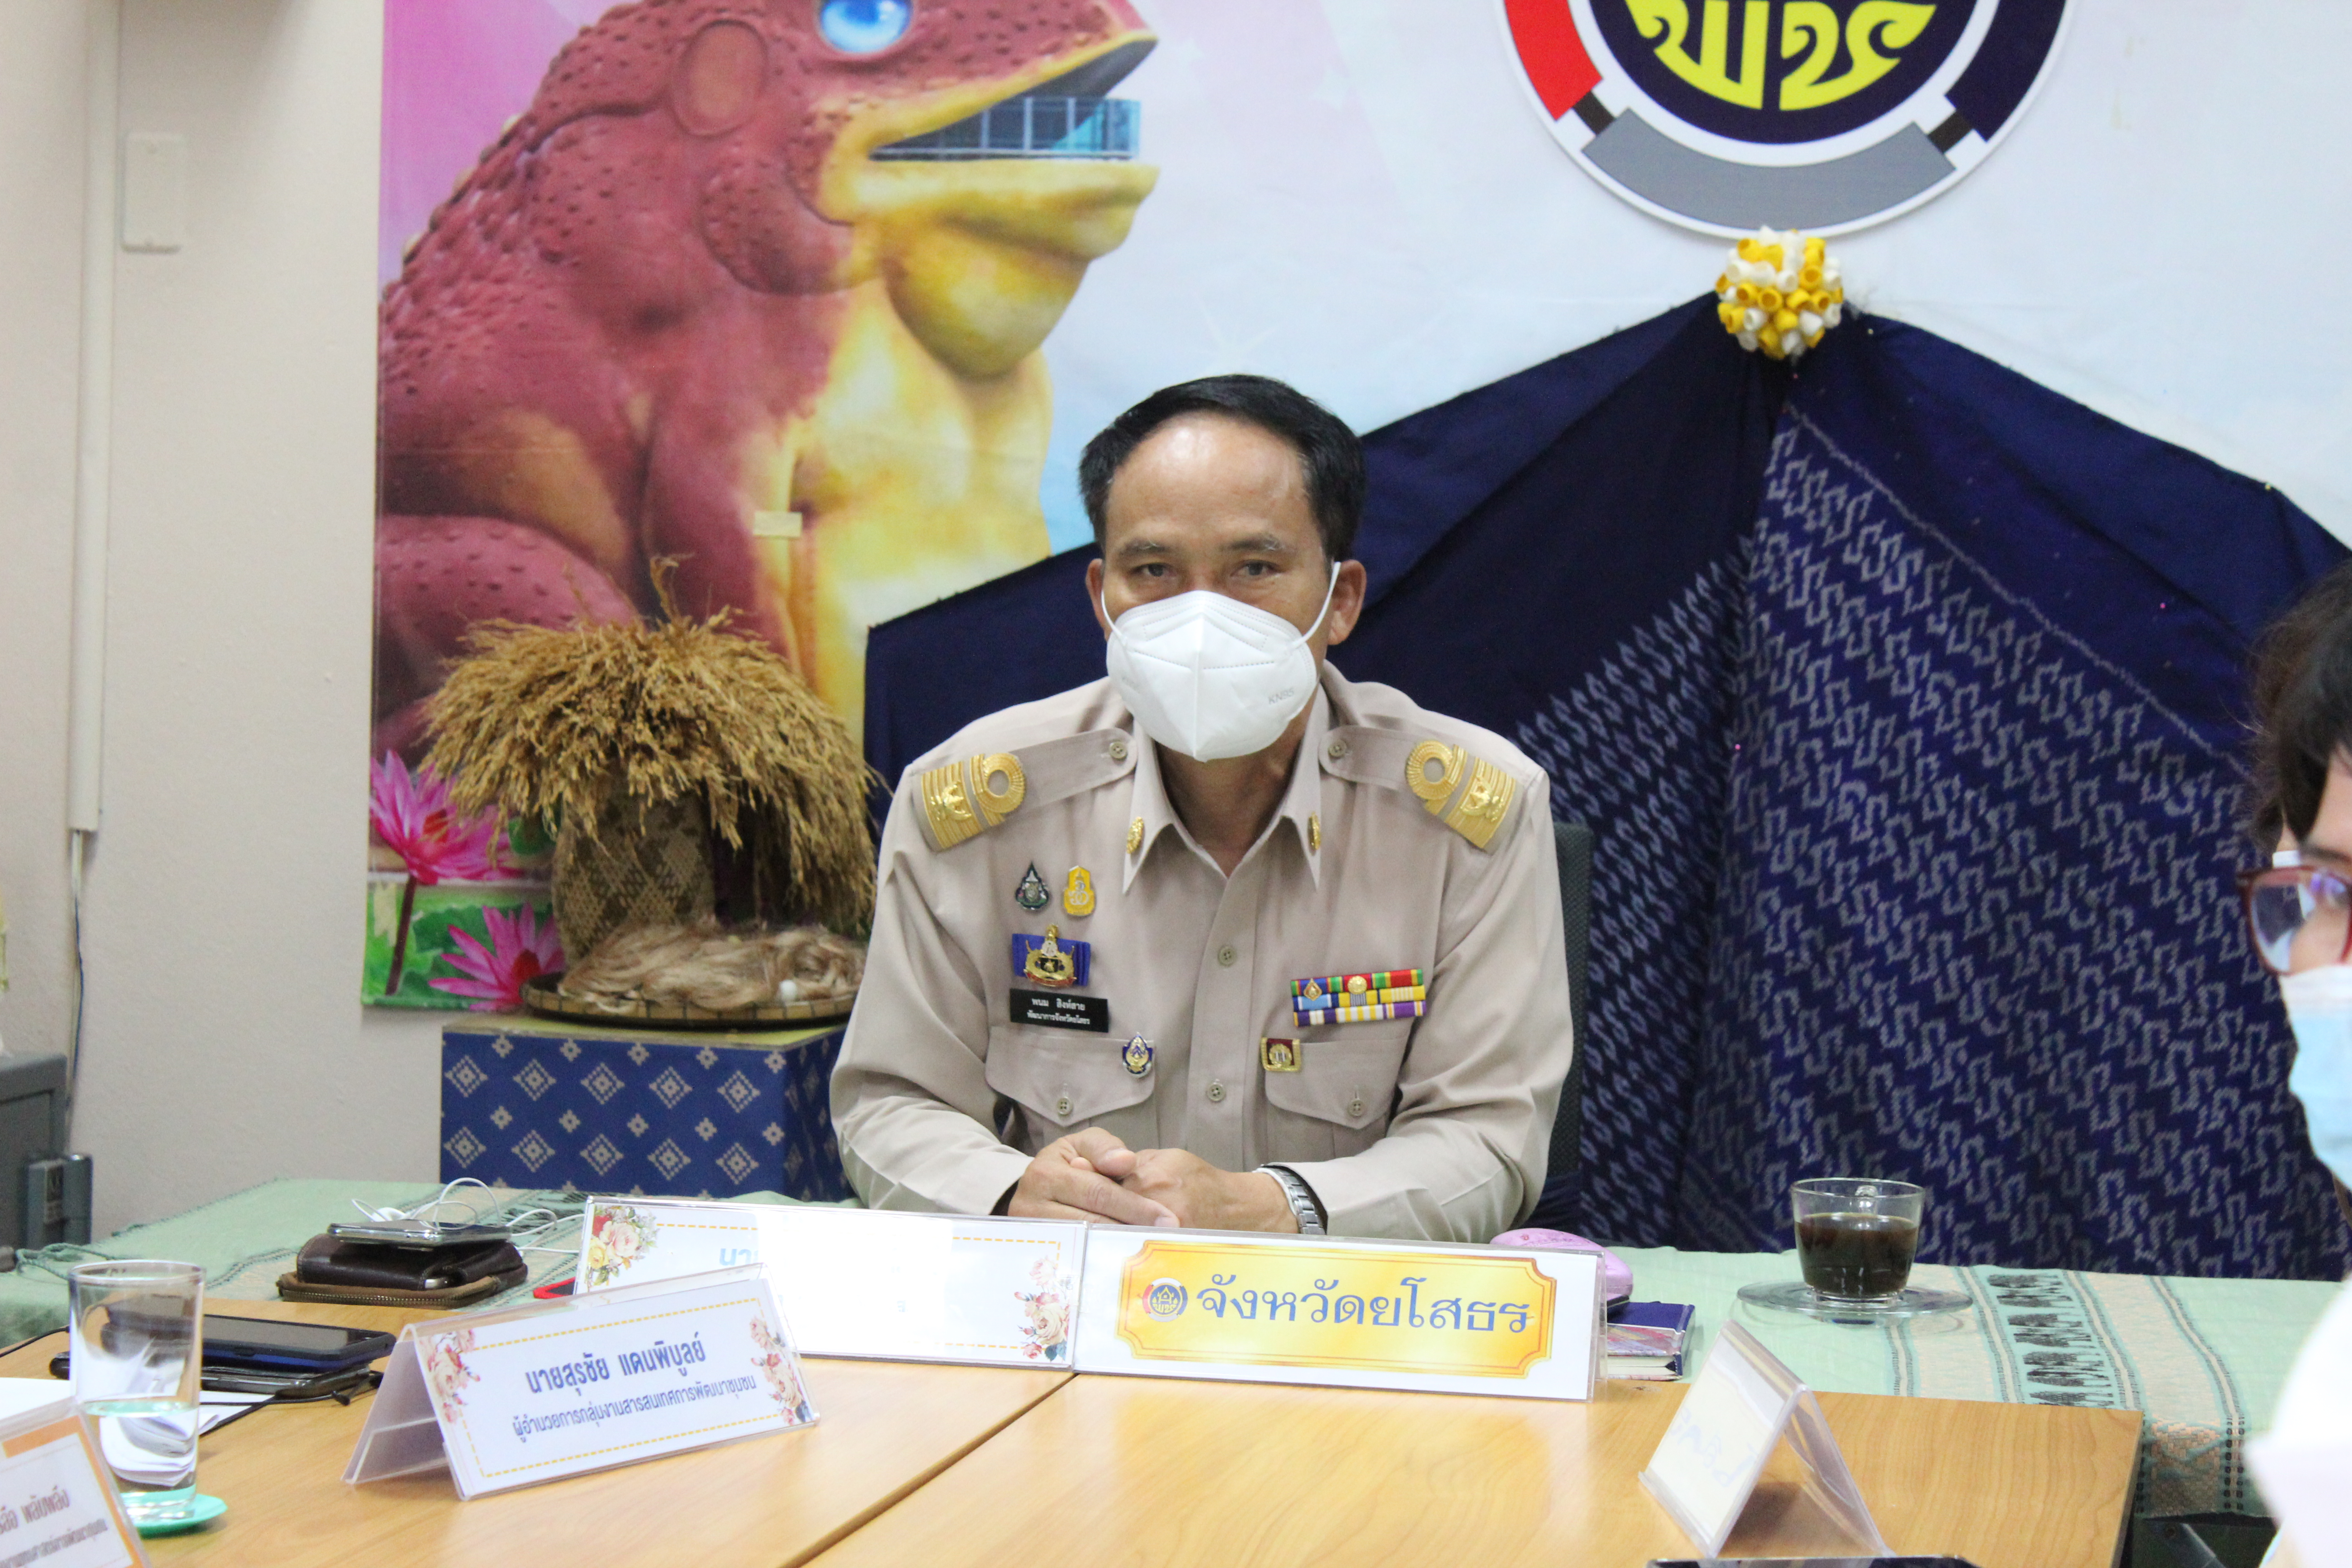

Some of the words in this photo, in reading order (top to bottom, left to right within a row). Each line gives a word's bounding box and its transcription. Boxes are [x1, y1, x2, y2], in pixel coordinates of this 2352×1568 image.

[1268, 687, 1295, 705] KN95
[1196, 1273, 1530, 1333] จังหวัดยโสธร
[525, 1352, 610, 1396] นายสุรชัย
